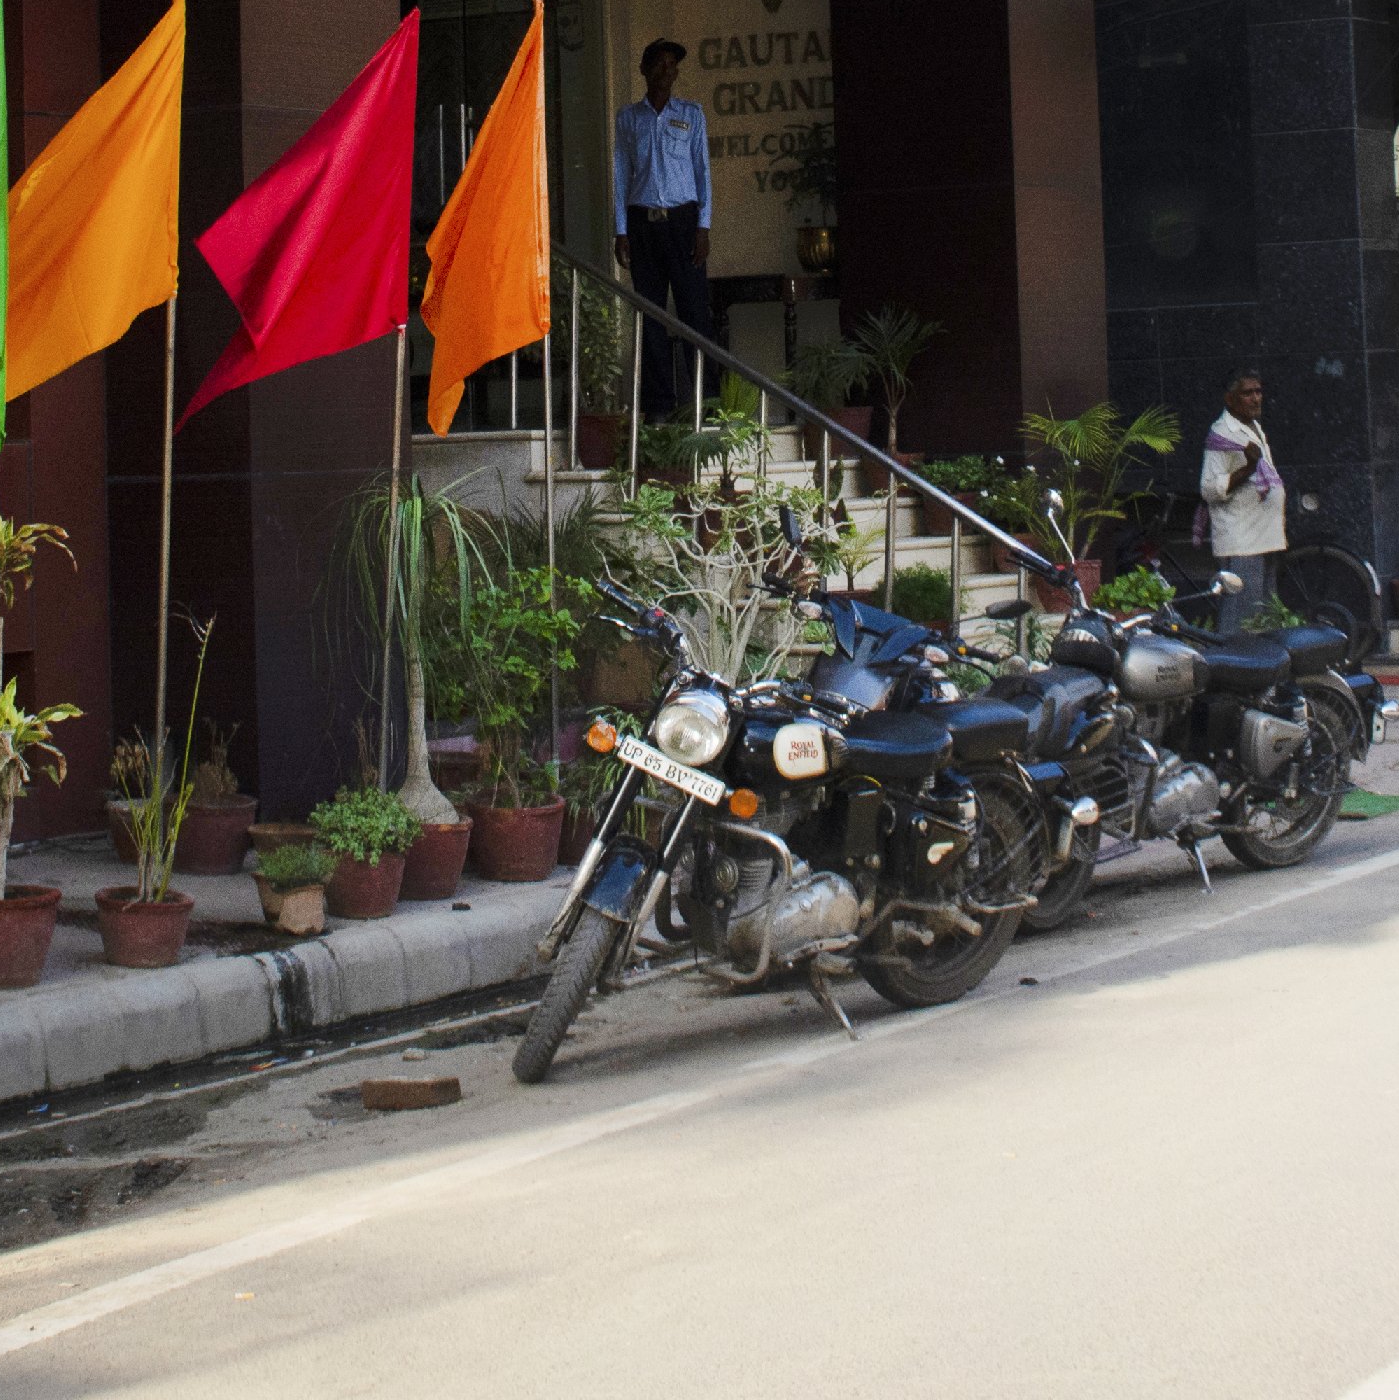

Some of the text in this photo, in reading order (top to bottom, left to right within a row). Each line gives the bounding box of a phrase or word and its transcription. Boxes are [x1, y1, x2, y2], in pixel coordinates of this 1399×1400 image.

[698, 29, 833, 70] GAUTA
[787, 750, 819, 761] ENFIELD
[790, 740, 815, 750] ROYAL
[623, 741, 719, 799] UP 65 BV 7761
